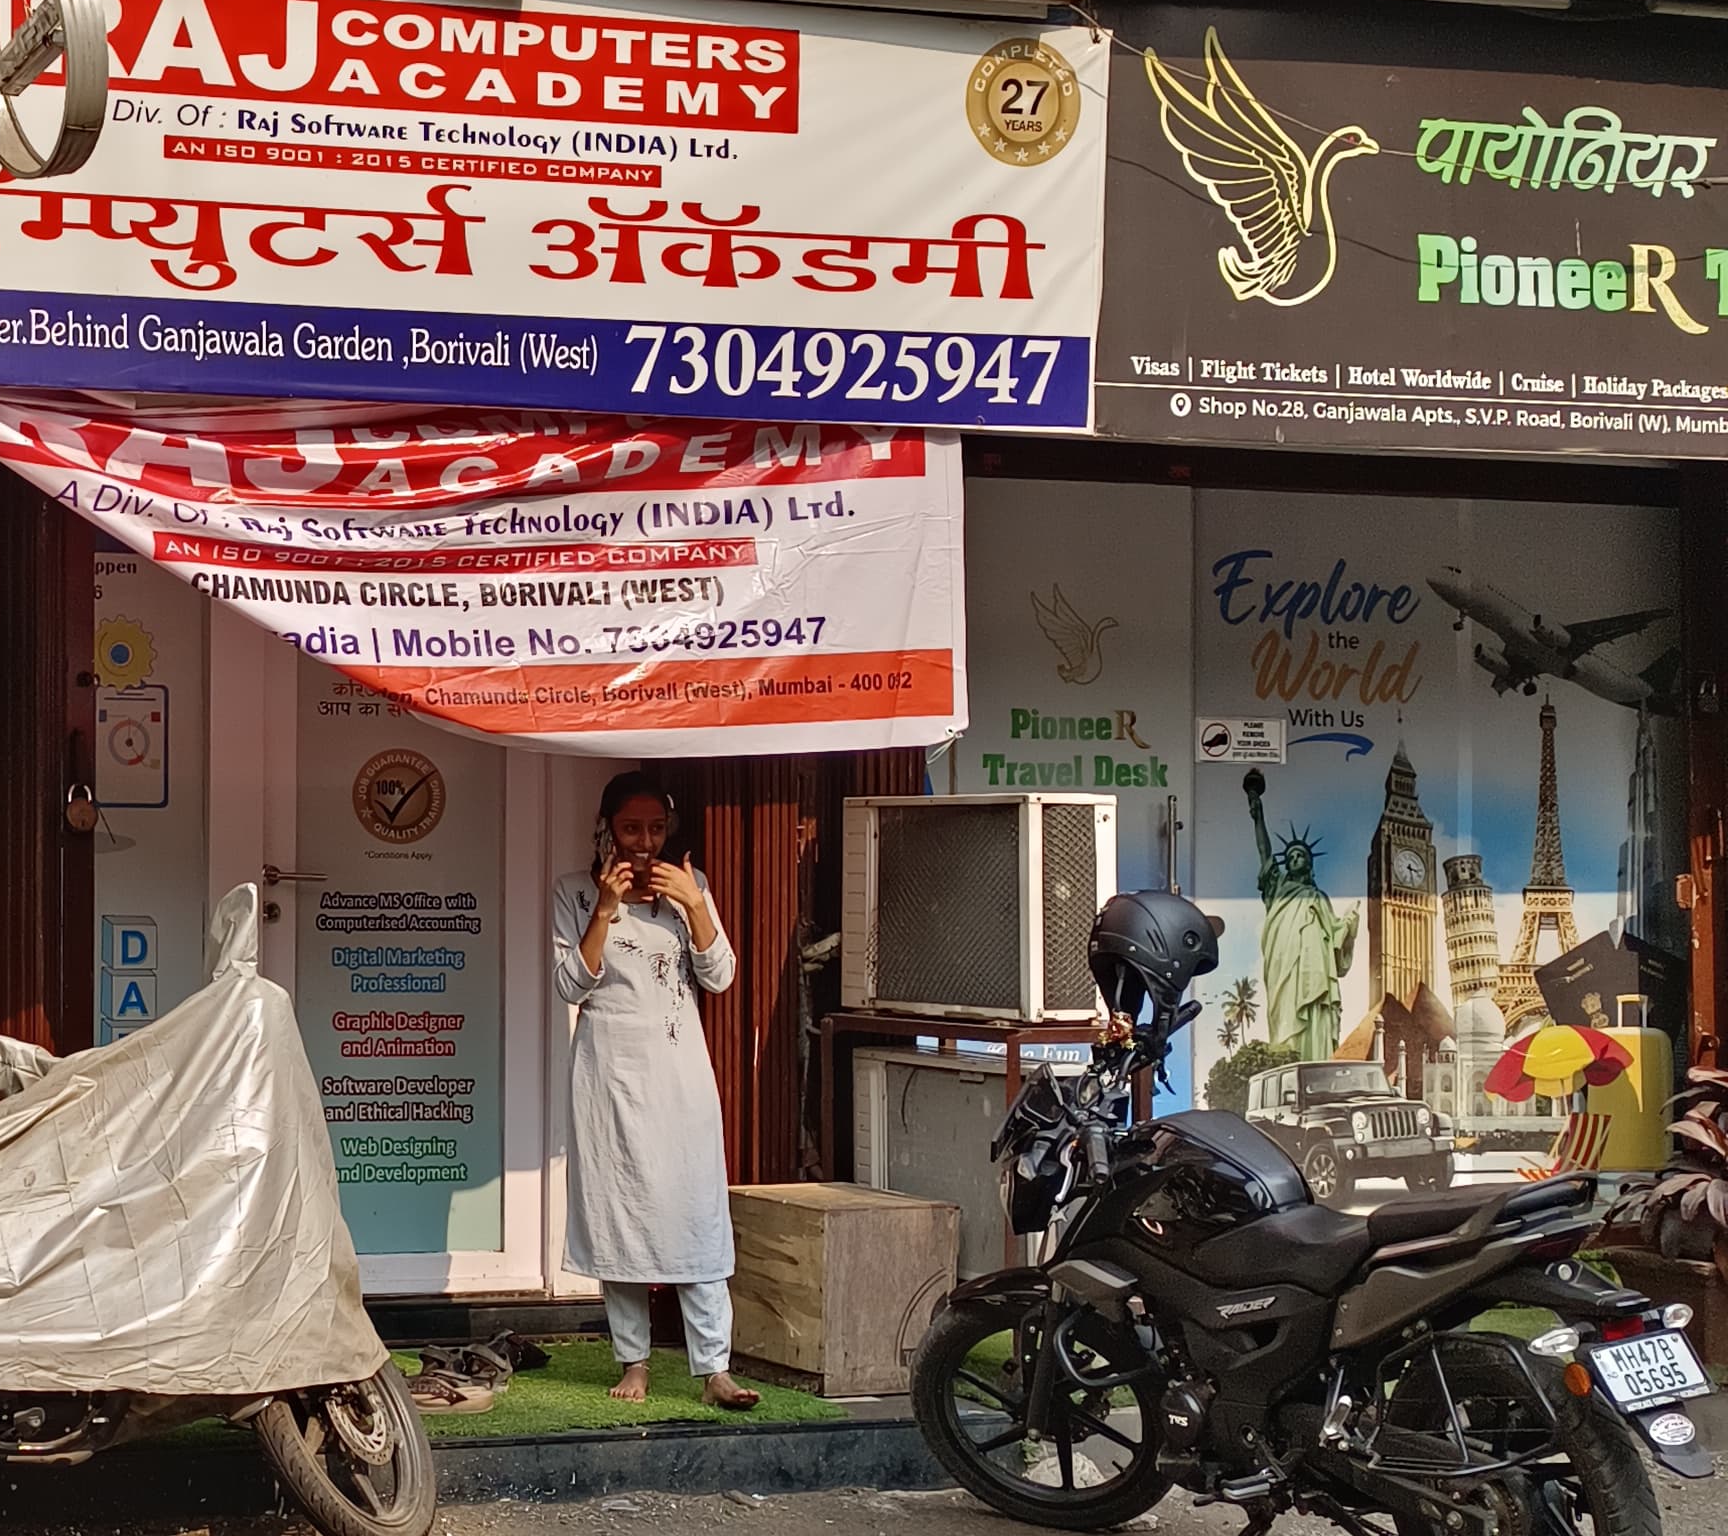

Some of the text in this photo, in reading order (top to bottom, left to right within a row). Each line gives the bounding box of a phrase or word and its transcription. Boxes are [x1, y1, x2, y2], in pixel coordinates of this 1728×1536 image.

[331, 9, 787, 75] COMPUTERS
[974, 45, 1073, 96] COMPLETED
[327, 57, 787, 120] ACADEMY
[1000, 78, 1050, 115] 27
[112, 98, 163, 125] Div.
[177, 103, 213, 127] Of
[572, 130, 679, 162] (INDIA)
[1004, 120, 1042, 132] YEARS
[171, 141, 654, 182] AN ISO 9001 2015 CERTIFIED COMPANY
[1416, 106, 1718, 199] पायोनियर
[1417, 233, 1710, 335] PioneeR
[138, 314, 286, 362] Ganjawala
[292, 321, 394, 363] Garden
[519, 331, 599, 376] (West)
[624, 322, 1063, 407] 7304925947
[1130, 356, 1728, 404] Visas Flight Tickets Hotel Worldwide Cruise Holiday Packages
[1199, 396, 1247, 419] Shop
[1252, 399, 1308, 420] No.28,
[1313, 401, 1407, 424] Ganjawala
[1411, 406, 1461, 426] Apts.,
[1464, 407, 1512, 426] S.V.P.
[1516, 410, 1566, 430] Road,
[1570, 412, 1633, 431] Borivali
[353, 424, 902, 498] ACADEMY
[52, 481, 80, 509] A
[93, 483, 155, 520] Div.
[636, 497, 773, 534] (INDIA)
[164, 540, 747, 568] AN ISO CERTIFIED COMPANY
[191, 571, 725, 612] CHAMUNDA CIRCLE, BORIVALI (WEST)
[1212, 550, 1420, 640] Explore
[393, 627, 592, 658] Mobile No.
[1328, 631, 1360, 649] the
[1251, 629, 1423, 705] World
[425, 687, 529, 706] Chamunda
[534, 686, 596, 707] Circle,
[759, 675, 833, 697] Mumbai
[851, 672, 883, 692] 400
[318, 701, 351, 716] आप
[358, 702, 381, 716] का
[1288, 708, 1364, 728] With Us
[1011, 708, 1151, 749] PioneeR
[376, 779, 405, 795] 100%
[982, 754, 1168, 787] Travel Desk
[374, 823, 419, 839] QUALITY
[322, 893, 475, 909] Advance MS Office with
[317, 914, 480, 932] Computerised Accounting
[333, 948, 464, 968] Digital Marketing
[352, 974, 445, 992] Professional
[334, 1013, 463, 1032] Graphic Designer
[342, 1038, 454, 1055] and Animation
[324, 1077, 473, 1096] Software Developer
[326, 1103, 472, 1122] and Ethical Hacking
[342, 1138, 455, 1157] Web Designing
[364, 1165, 466, 1183] Development
[1609, 1338, 1675, 1372] MH47B
